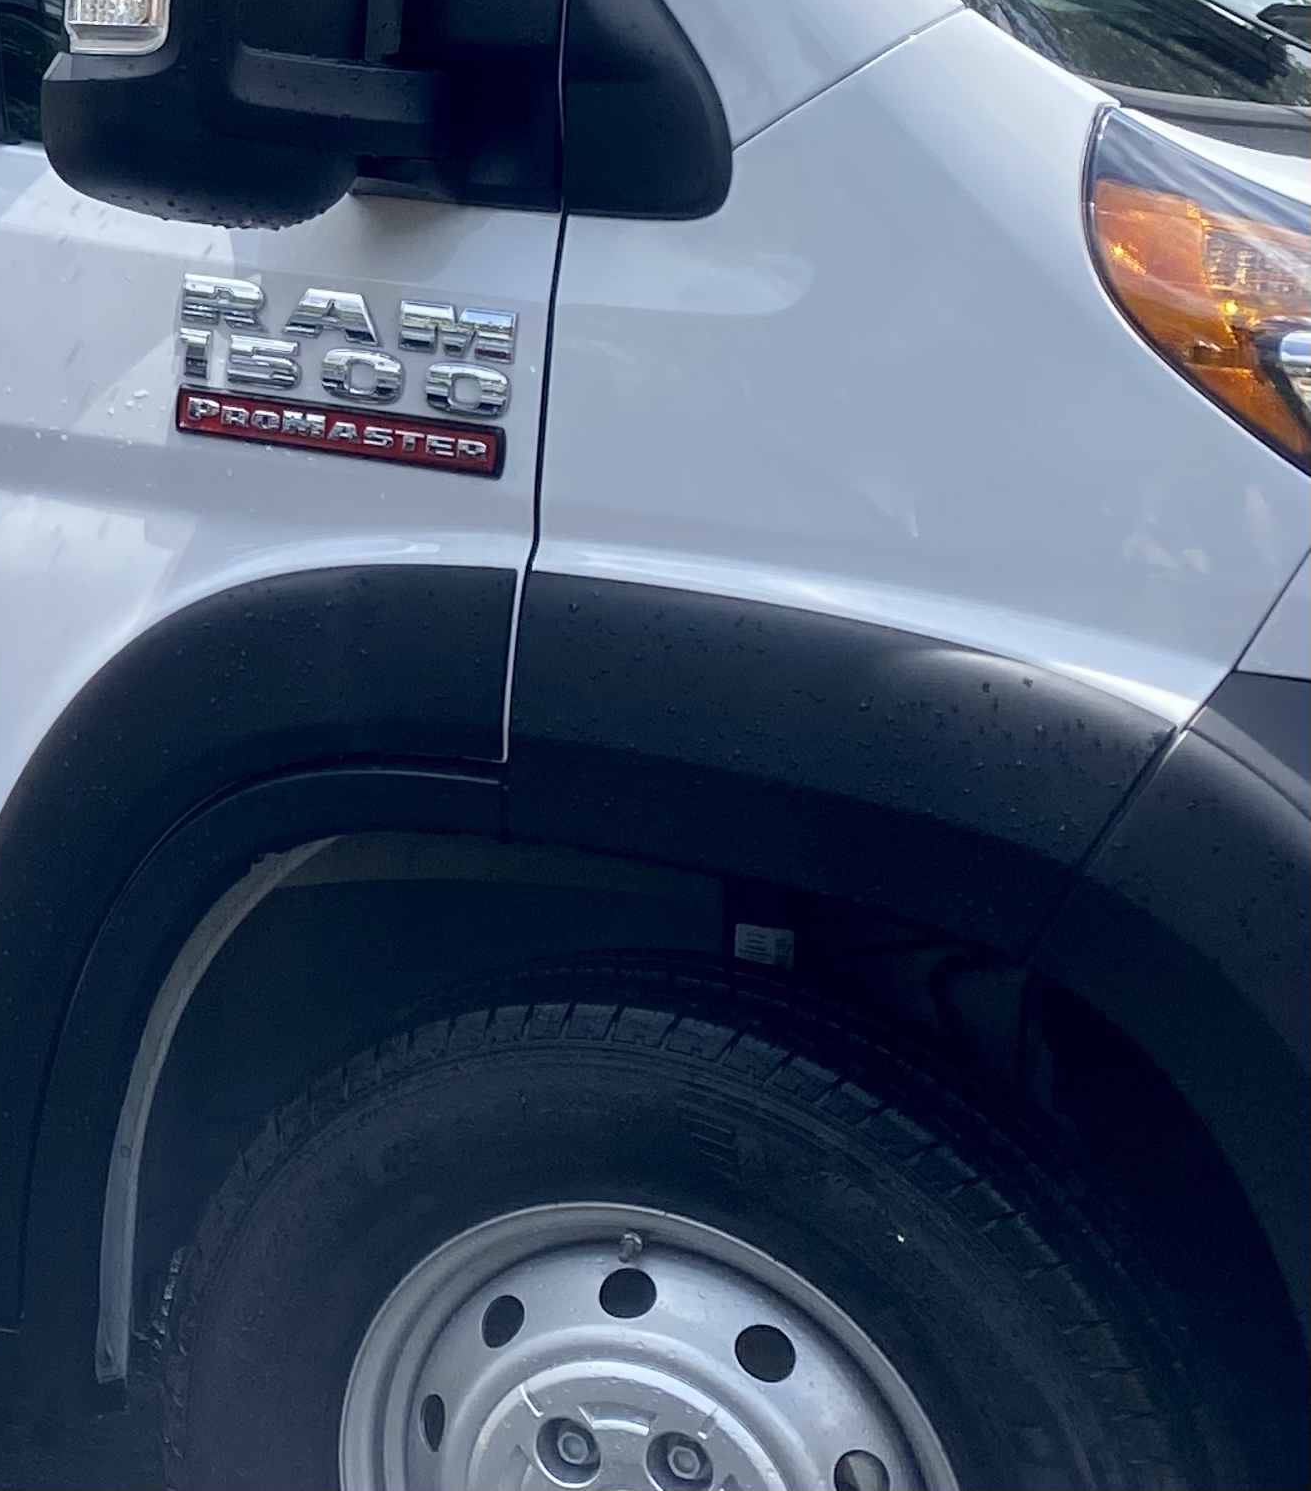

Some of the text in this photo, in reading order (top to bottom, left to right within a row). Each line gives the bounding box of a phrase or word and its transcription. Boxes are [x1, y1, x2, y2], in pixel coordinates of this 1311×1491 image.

[181, 273, 519, 363] RAM
[179, 327, 512, 418] 1500
[187, 396, 488, 462] PROMASTER
